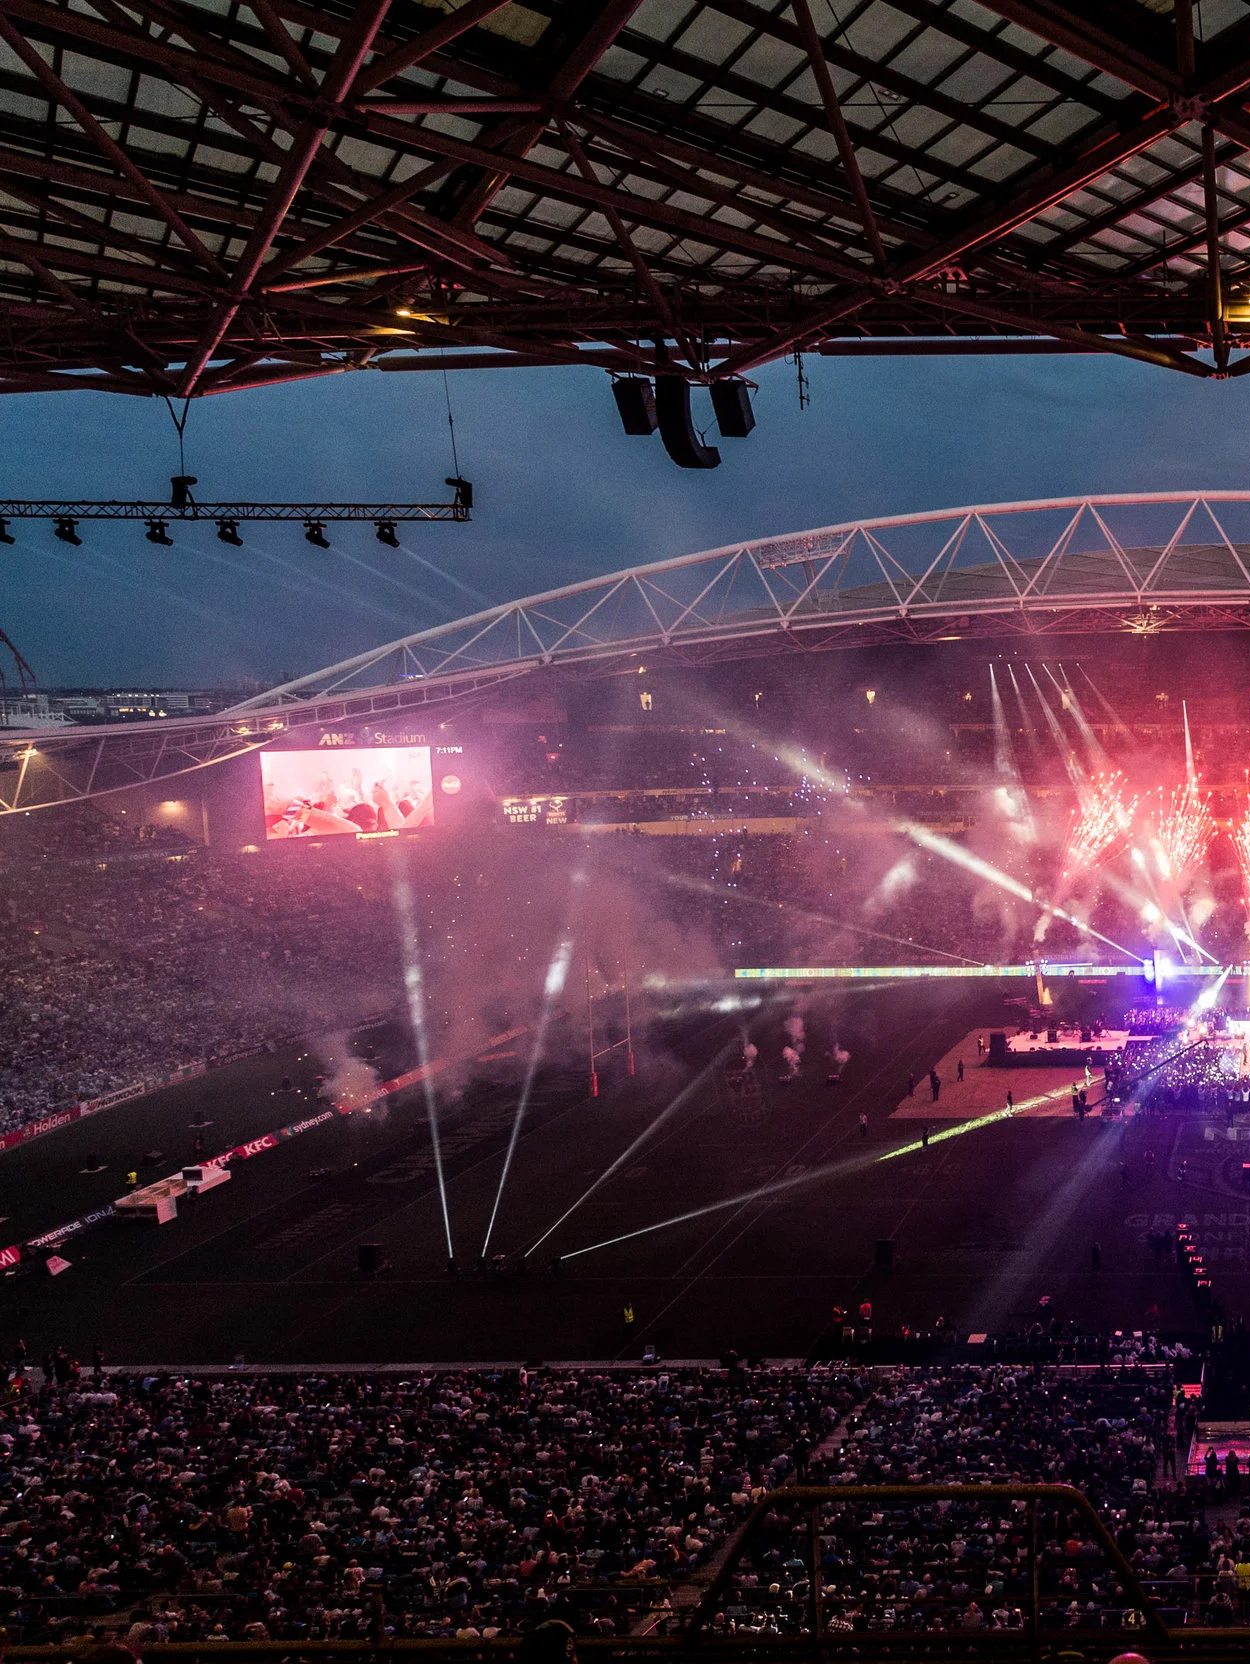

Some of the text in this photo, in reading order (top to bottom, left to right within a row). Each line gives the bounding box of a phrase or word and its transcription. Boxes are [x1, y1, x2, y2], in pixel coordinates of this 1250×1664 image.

[318, 731, 426, 745] ANZ Stadium
[436, 746, 463, 754] 7:11PM
[504, 805, 542, 815] NSW #1
[510, 814, 537, 823] BEER
[546, 817, 568, 825] NEW
[356, 830, 399, 840] Panasonic
[33, 1113, 71, 1135] Holden
[293, 1111, 334, 1132] sydney.com
[244, 1136, 274, 1158] KFC
[84, 1205, 117, 1225] ION4
[1128, 1613, 1136, 1624] 4
